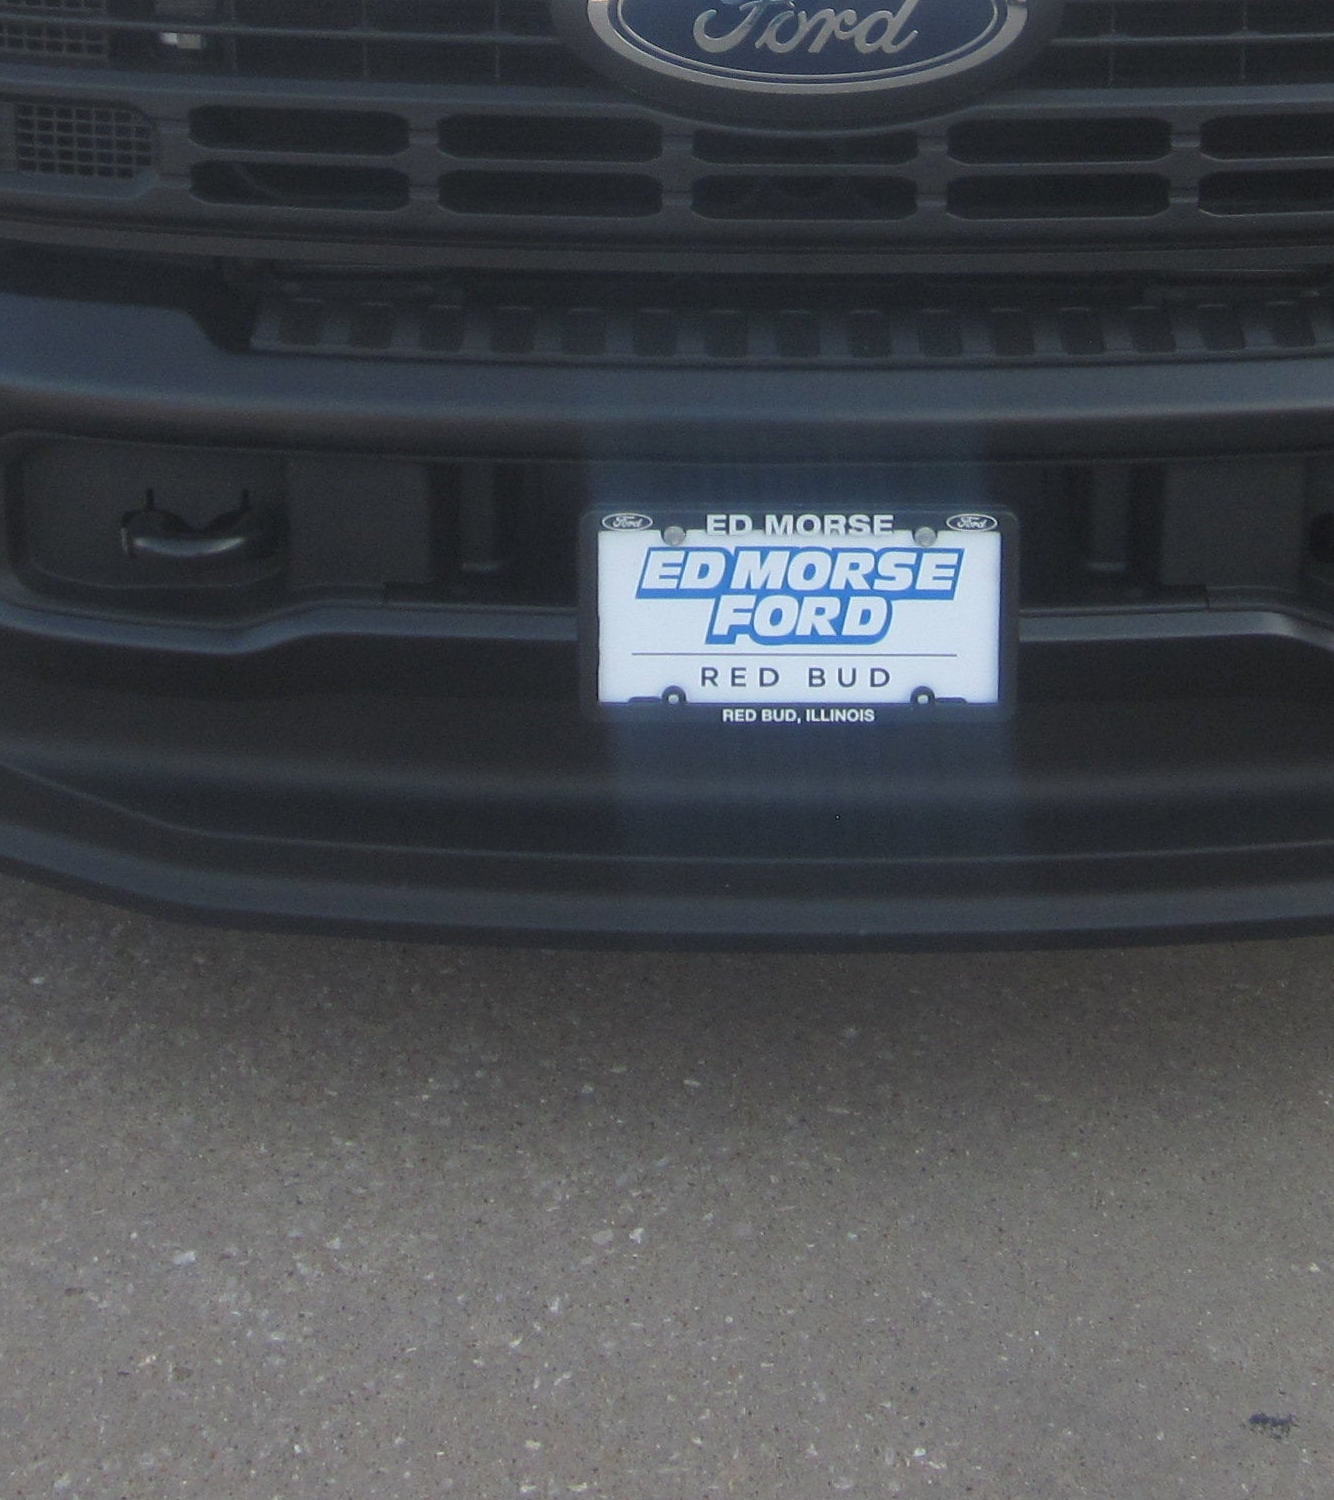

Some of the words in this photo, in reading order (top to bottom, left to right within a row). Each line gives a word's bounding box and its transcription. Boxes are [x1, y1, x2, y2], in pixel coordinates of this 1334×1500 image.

[706, 514, 753, 536] ED
[764, 514, 895, 536] MORSE
[730, 550, 961, 591] MORSE
[712, 596, 888, 637] FORD
[701, 667, 780, 687] RED
[808, 667, 891, 688] BUD
[722, 708, 757, 723] RED
[761, 708, 802, 725] BUD,
[806, 708, 875, 723] ILLINOIS
